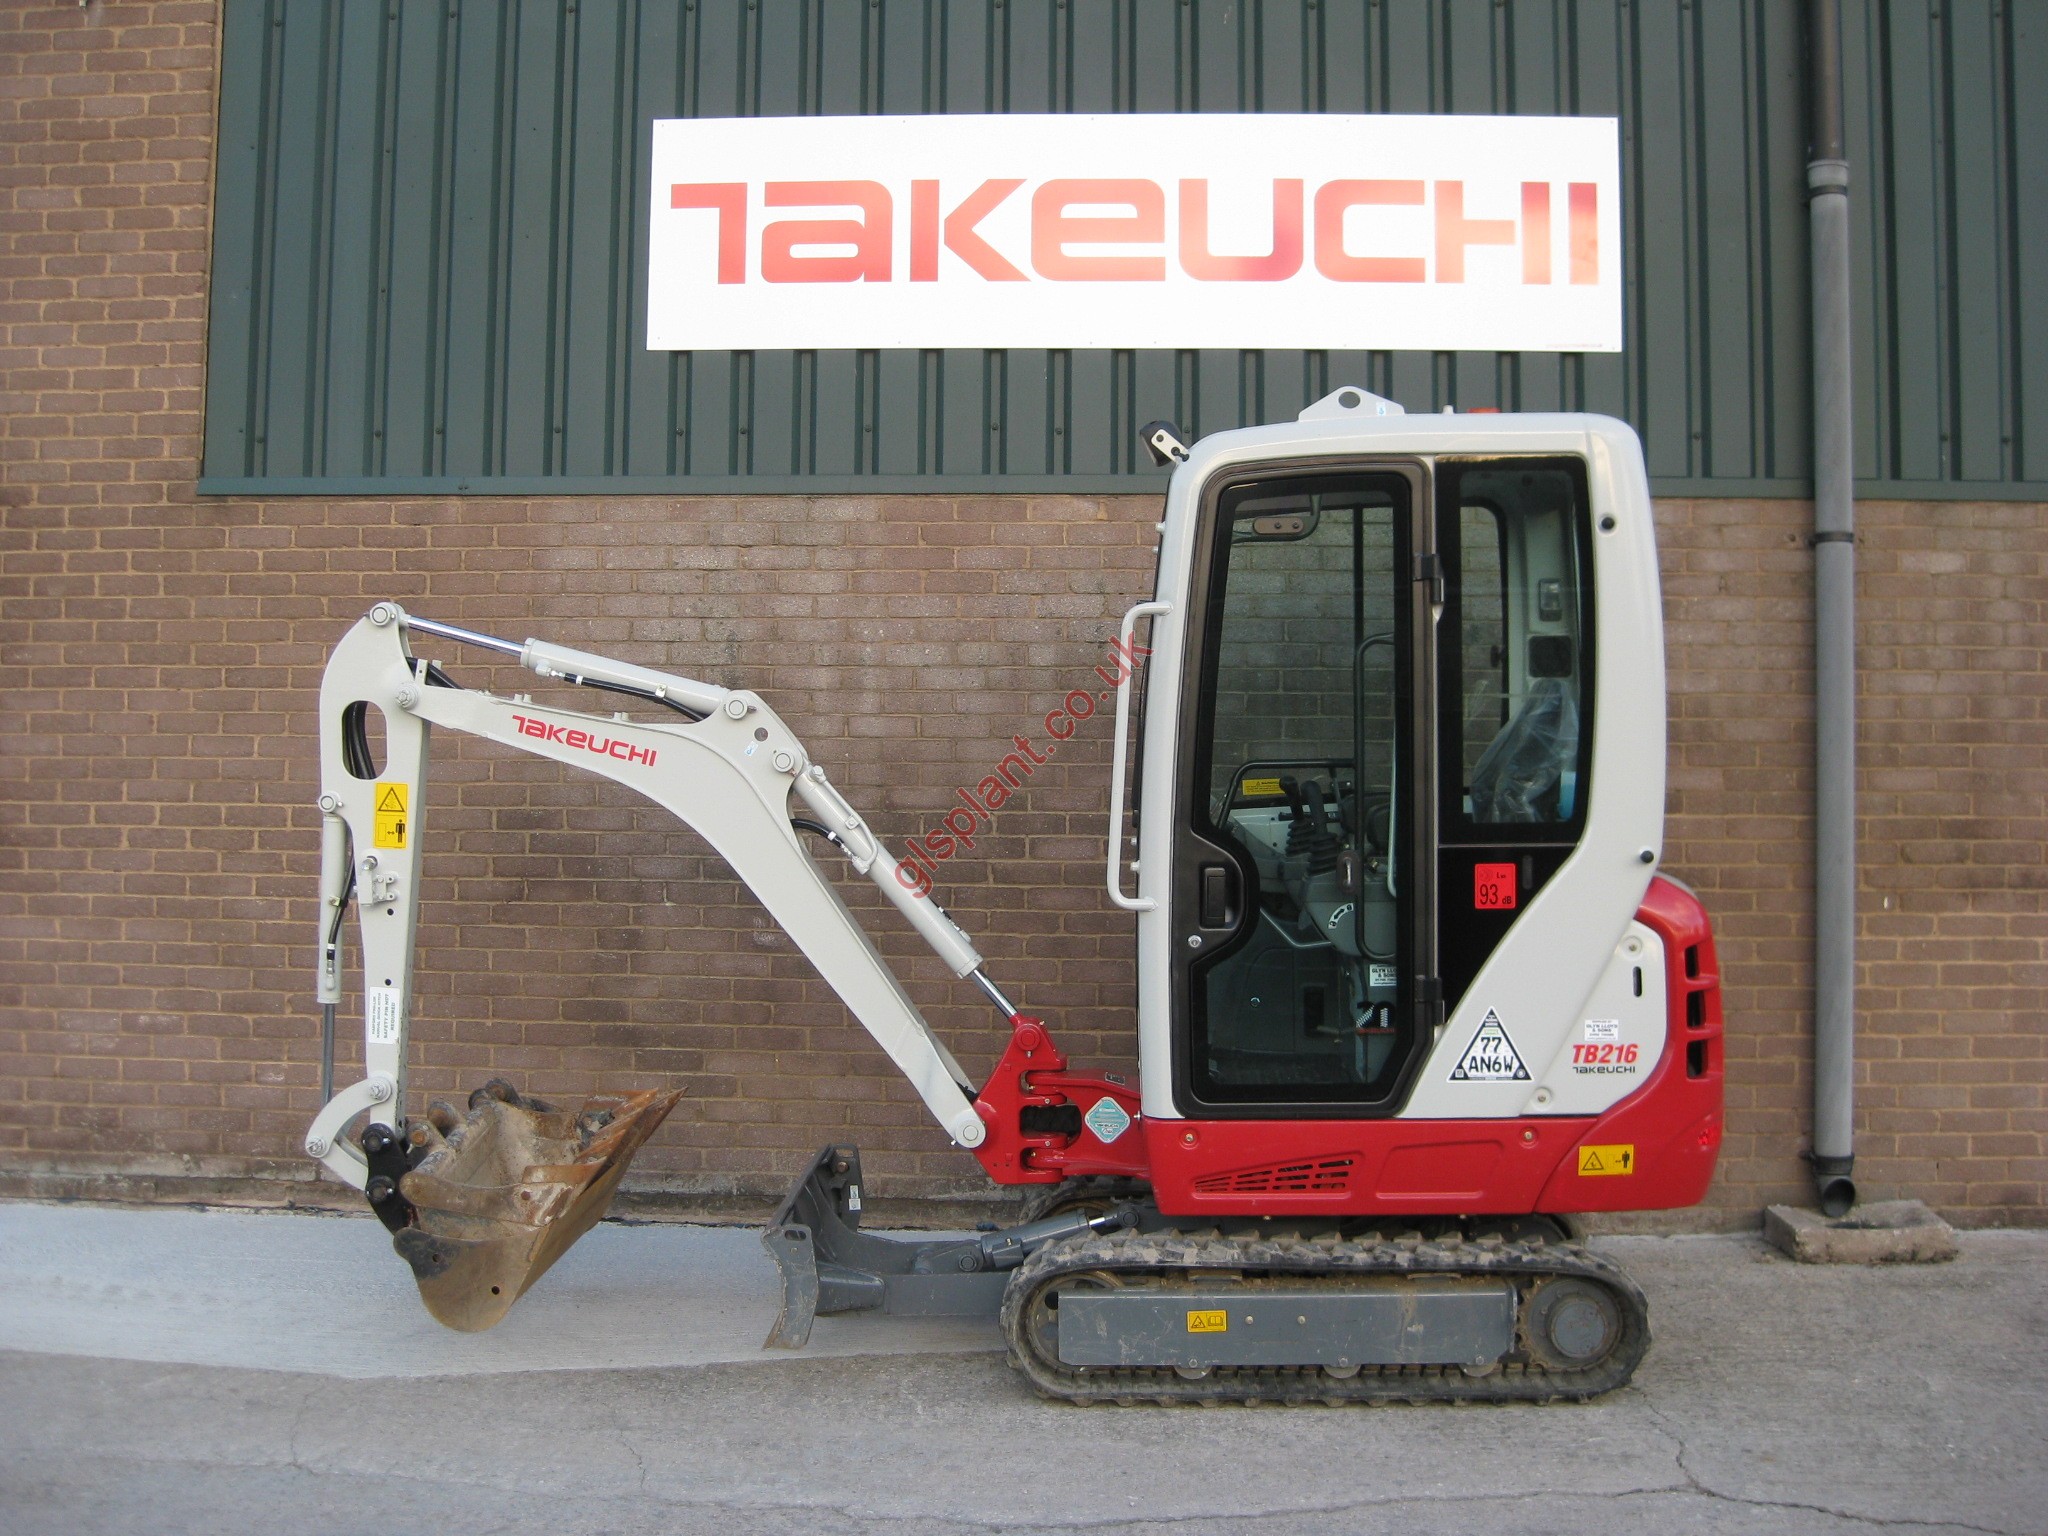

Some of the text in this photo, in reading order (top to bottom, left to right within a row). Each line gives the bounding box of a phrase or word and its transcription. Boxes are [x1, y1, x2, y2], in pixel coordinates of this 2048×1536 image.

[671, 178, 1598, 284] TAKEUCHI
[512, 715, 657, 767] TAKEUCHI
[1480, 884, 1511, 905] 93 dB
[1480, 1036, 1502, 1053] 77
[1573, 1044, 1637, 1064] TB216
[1468, 1055, 1514, 1073] AN6W
[1572, 1066, 1636, 1074] TAKEUCHI
